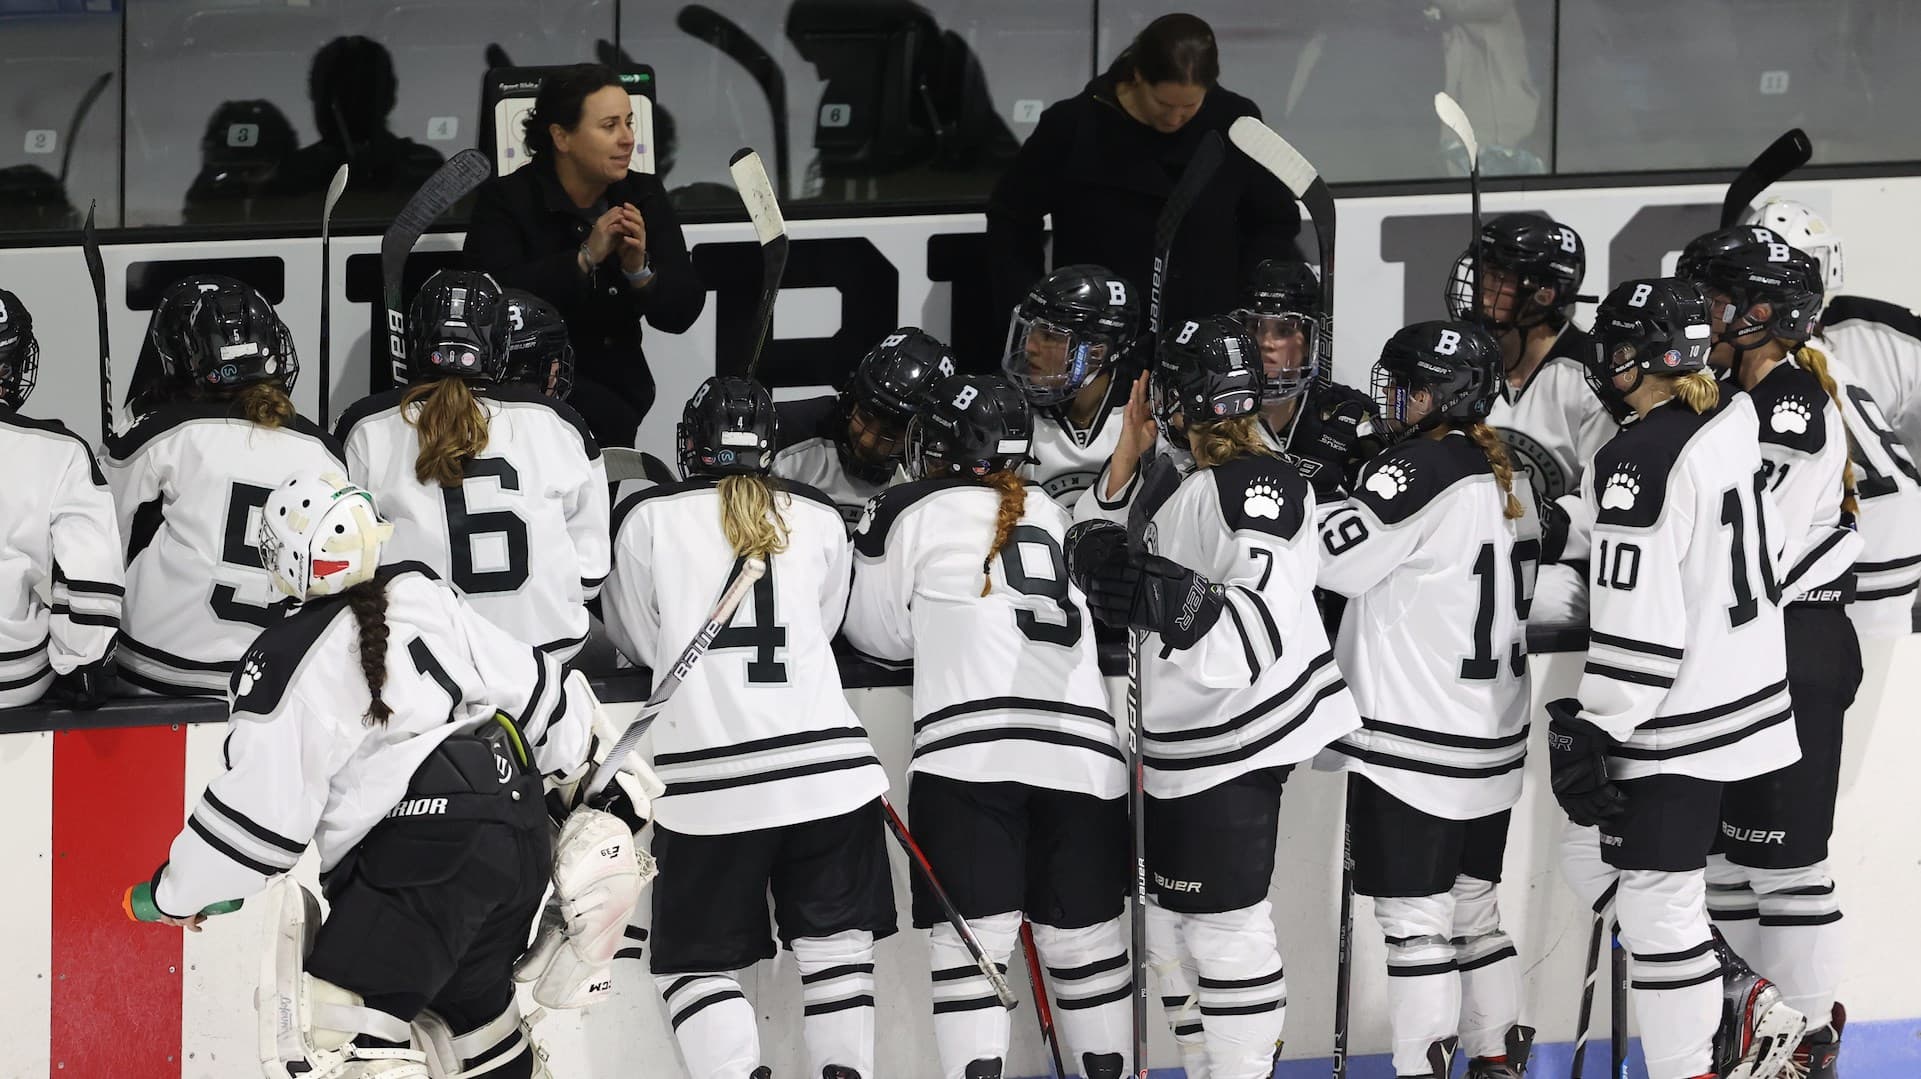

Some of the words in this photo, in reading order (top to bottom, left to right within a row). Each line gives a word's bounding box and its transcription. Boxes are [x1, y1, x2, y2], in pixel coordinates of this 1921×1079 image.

[437, 121, 448, 136] 4
[830, 108, 841, 123] 6
[237, 127, 249, 143] 3
[1559, 227, 1577, 254] B
[1768, 243, 1791, 262] B
[1106, 280, 1127, 306] B
[1150, 257, 1163, 334] BAUER
[1628, 283, 1653, 308] B
[233, 328, 240, 342] 5
[1175, 320, 1200, 345] B
[1434, 329, 1461, 355] B
[388, 308, 409, 385] BAU
[1689, 344, 1701, 358] 10
[952, 384, 978, 411] B
[1234, 400, 1240, 414] 7
[737, 416, 744, 429] 4
[443, 456, 529, 594] 6
[1250, 547, 1273, 591] 7
[1597, 539, 1641, 592] 10
[1000, 525, 1081, 648] 9
[1793, 590, 1842, 602] AUER
[706, 553, 788, 683] 4
[673, 619, 723, 682] BAUE
[406, 636, 464, 722] 1
[1720, 820, 1786, 845] BAUER
[1138, 856, 1146, 905] BAUER
[588, 981, 612, 993] CM
